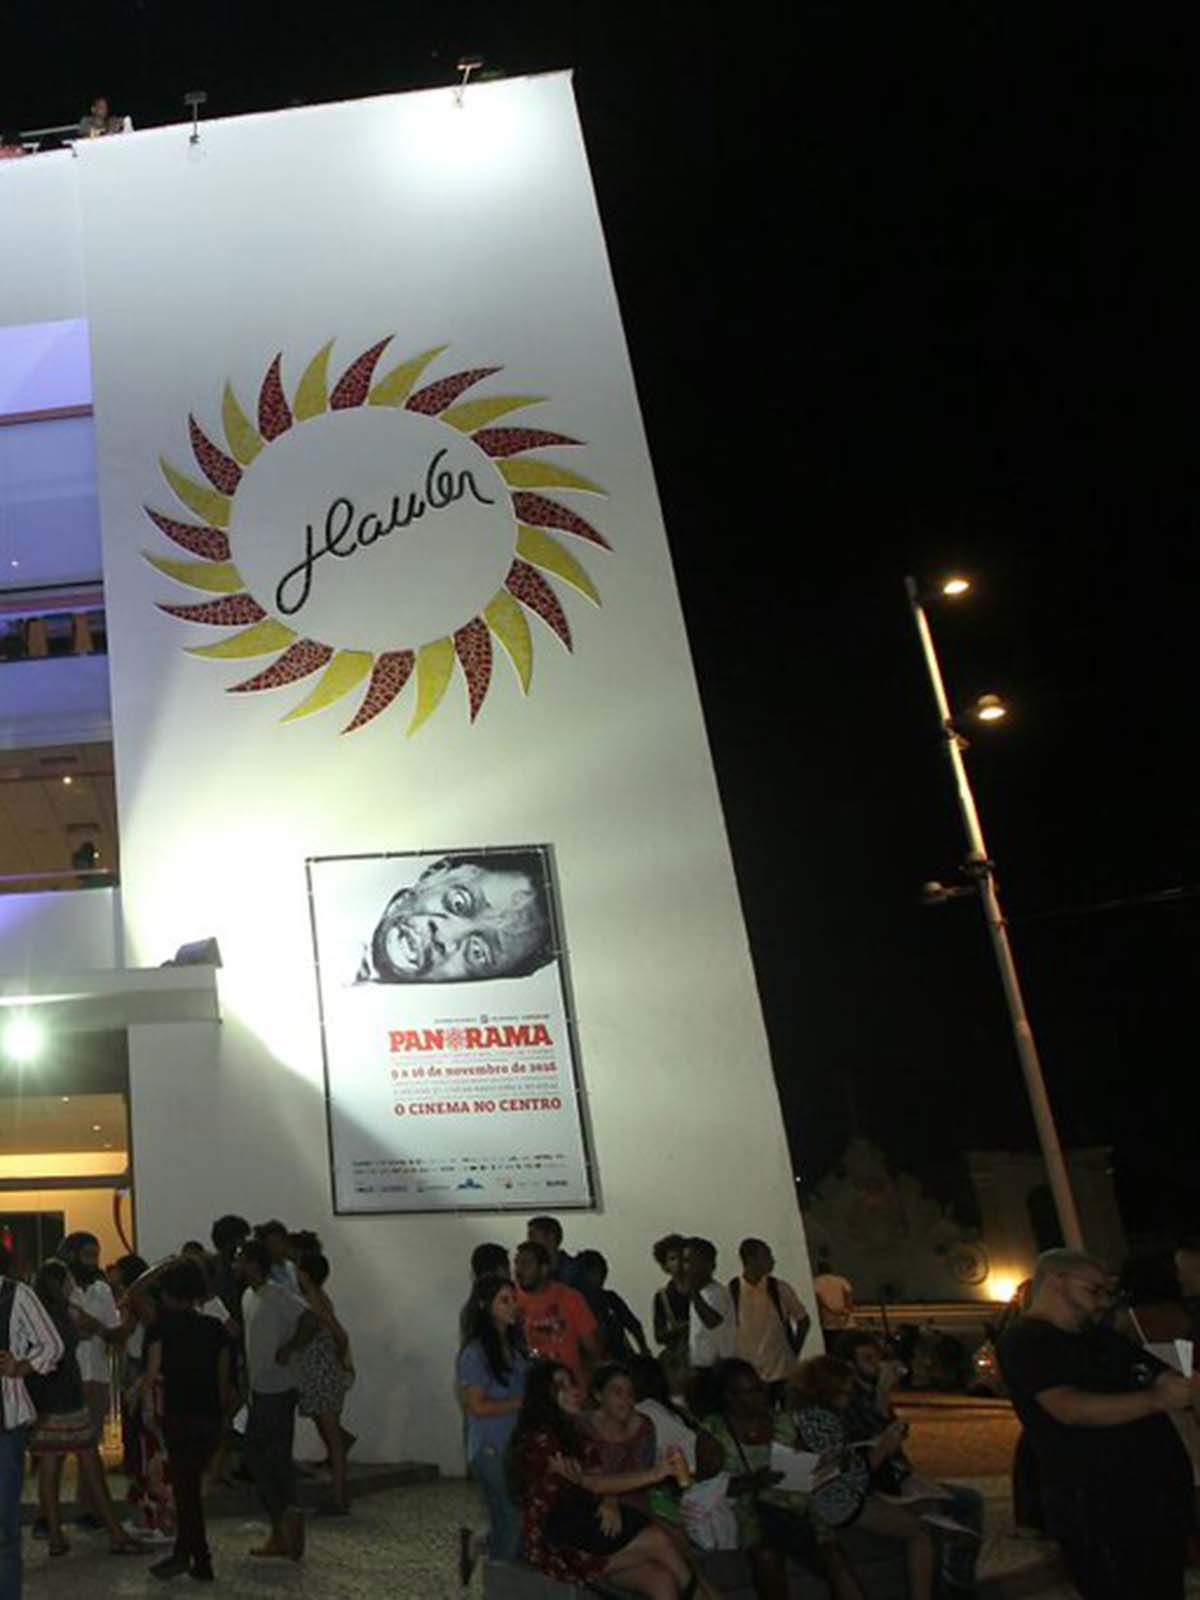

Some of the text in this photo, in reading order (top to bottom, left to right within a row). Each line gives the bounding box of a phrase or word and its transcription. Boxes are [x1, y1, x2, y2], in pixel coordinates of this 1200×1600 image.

[389, 1024, 554, 1053] PANORAMA
[427, 1065, 442, 1076] de
[445, 1062, 509, 1075] novembro
[511, 1061, 527, 1073] de
[394, 1097, 563, 1116] O CINEMA NO CENTRO
